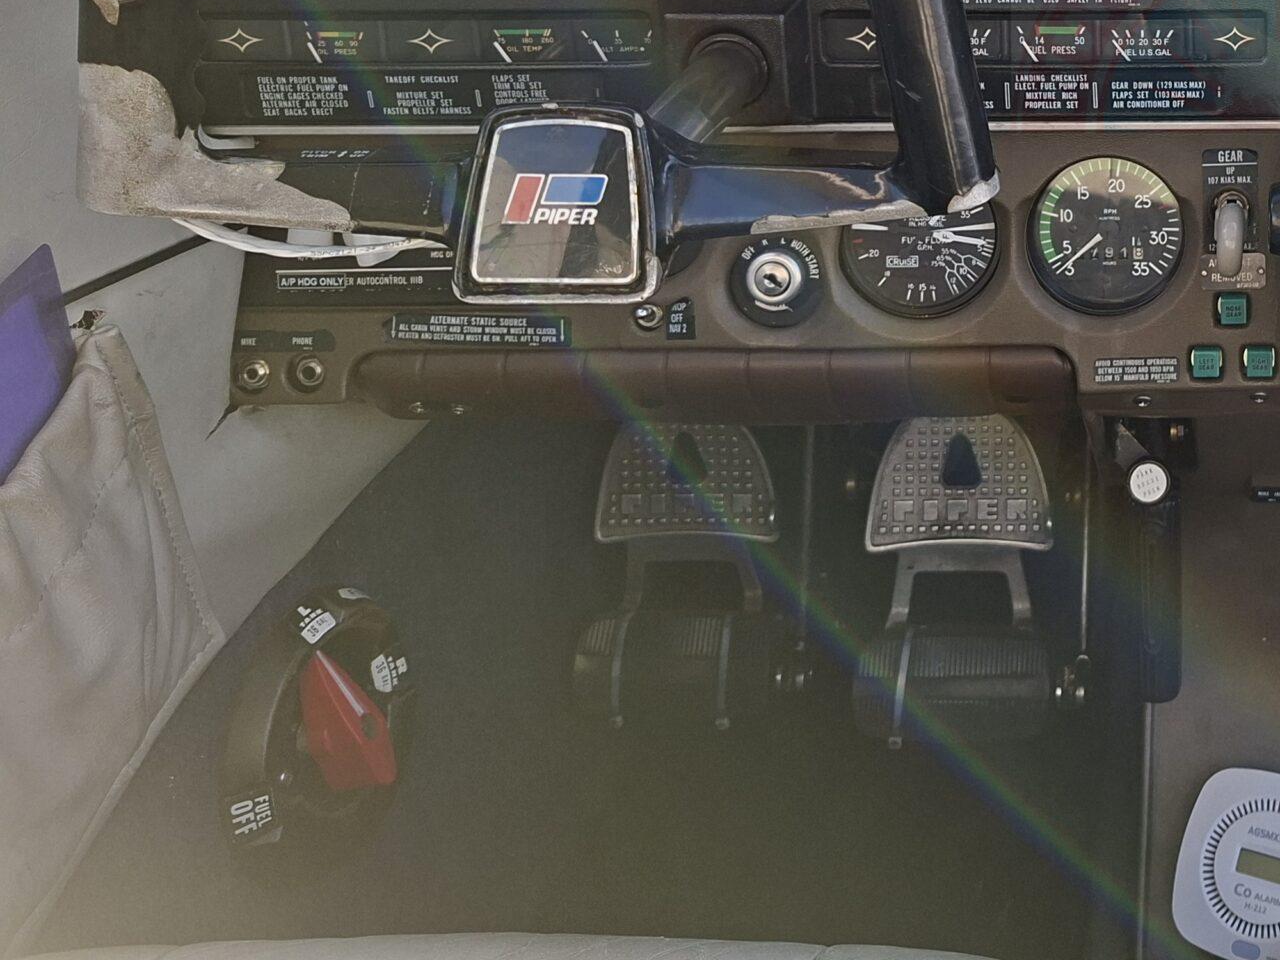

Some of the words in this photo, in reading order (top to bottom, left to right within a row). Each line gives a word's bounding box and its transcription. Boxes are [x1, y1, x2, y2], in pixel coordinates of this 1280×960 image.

[385, 75, 416, 84] TAKEOFF
[420, 75, 459, 83] CHECKLIST
[1015, 74, 1046, 82] LANDING
[1050, 74, 1088, 82] CHECKLIST
[258, 84, 295, 92] ELECTRIC
[1111, 81, 1130, 90] GEAR
[1133, 81, 1153, 90] DOWN
[1188, 81, 1207, 90] MAX)
[1111, 90, 1134, 99] FLAPS
[1136, 90, 1149, 99] SET
[1112, 100, 1124, 109] AIR
[1126, 100, 1170, 108] CONDITIONER
[1172, 100, 1185, 108] OFF
[1217, 150, 1244, 162] GEAR
[1107, 178, 1126, 193] 20
[1220, 176, 1236, 185] KIAS
[1134, 195, 1152, 209] 25
[533, 207, 599, 225] PIPER
[1060, 208, 1073, 223] 10
[1149, 231, 1168, 245] 30
[1131, 261, 1150, 276] 35
[298, 277, 318, 286] HDG
[319, 277, 344, 286] ONLY
[356, 276, 408, 286] AUTOCONTROL
[429, 316, 470, 326] ALTERNATE
[471, 317, 497, 326] STATIC
[499, 318, 528, 327] SOURCE
[292, 337, 313, 346] PHONE
[254, 795, 273, 828] FUEL
[230, 800, 258, 836] OFF
